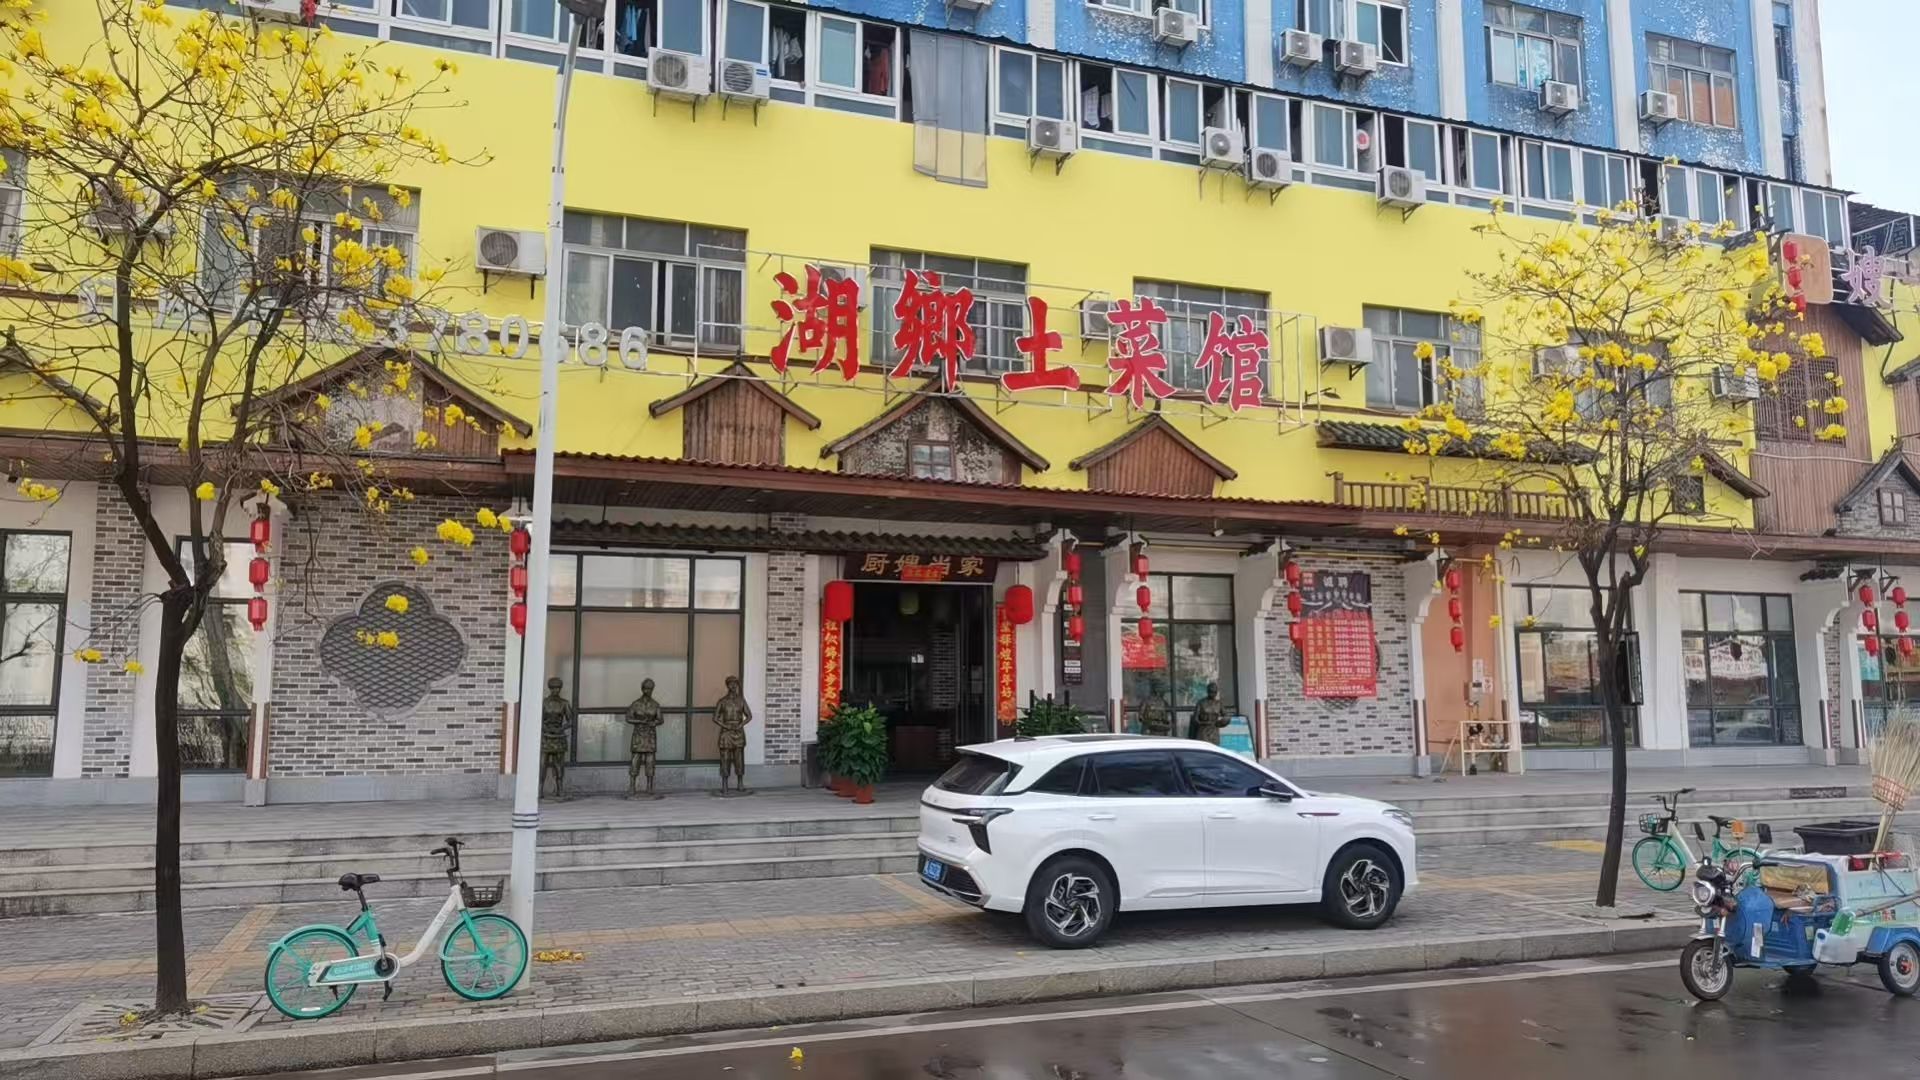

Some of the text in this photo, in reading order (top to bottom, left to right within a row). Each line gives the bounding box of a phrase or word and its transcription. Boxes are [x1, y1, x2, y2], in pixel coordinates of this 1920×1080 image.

[769, 264, 1270, 411] 湖鄉土菜馆
